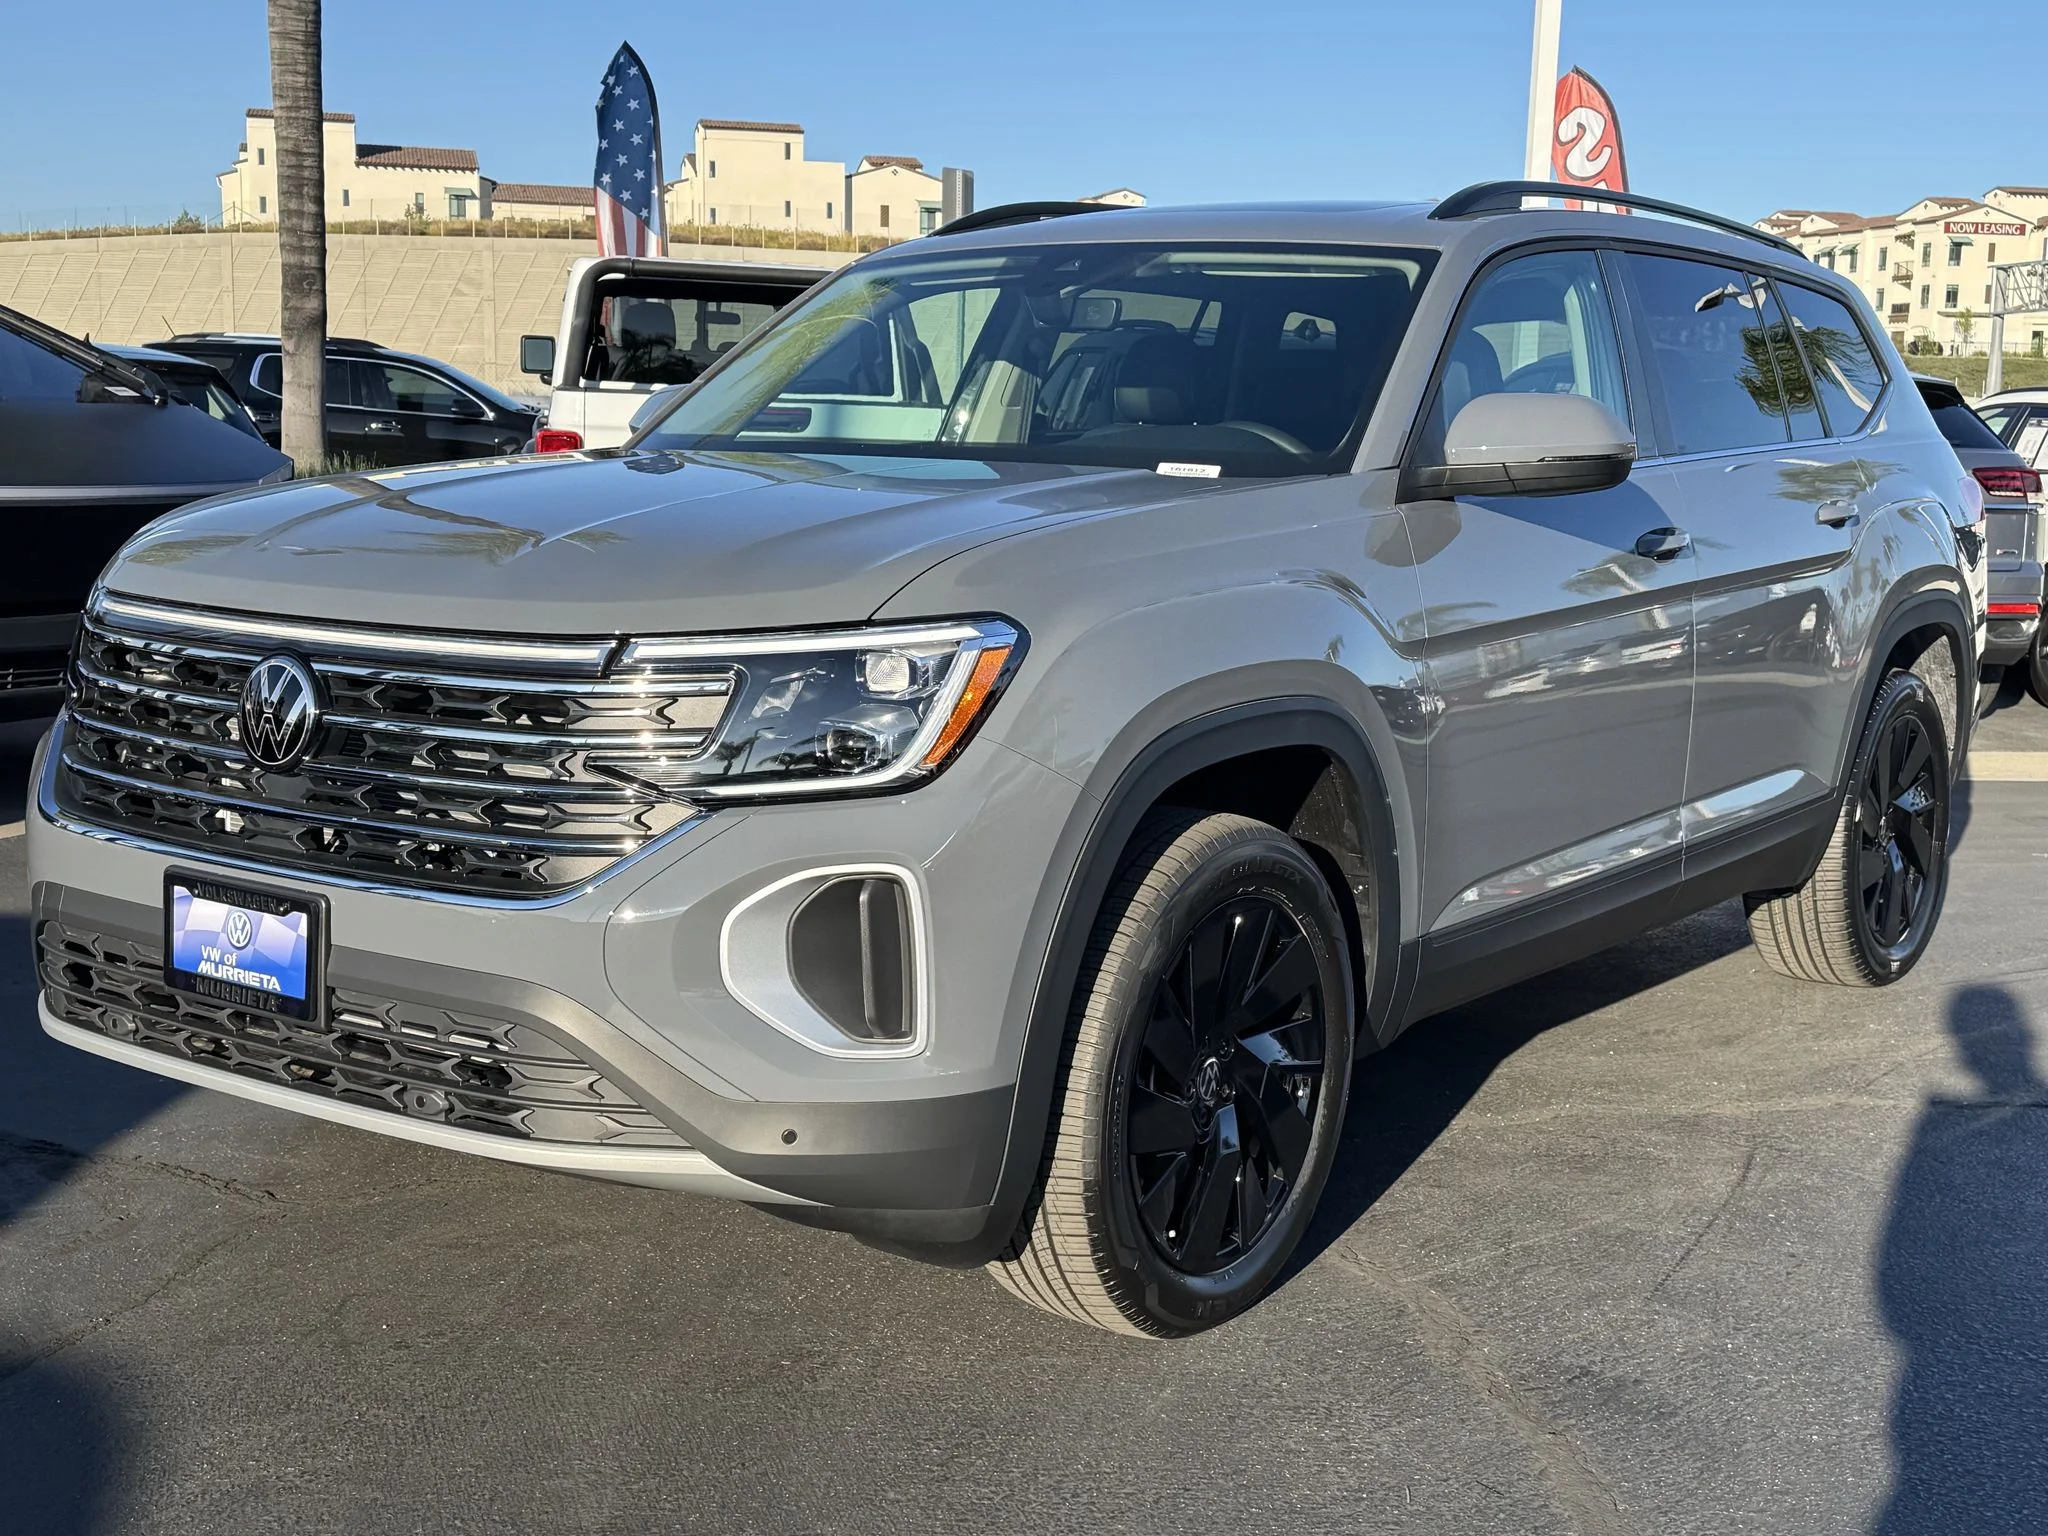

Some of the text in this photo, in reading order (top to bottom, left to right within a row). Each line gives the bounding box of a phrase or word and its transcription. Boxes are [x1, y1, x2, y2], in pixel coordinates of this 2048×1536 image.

[1949, 222, 2021, 235] NOW LEASING
[243, 660, 312, 766] VW
[196, 882, 277, 913] VOLKSWAGEN
[228, 910, 251, 949] VW
[201, 944, 238, 967] VW of
[197, 960, 281, 992] MURRIETA
[195, 976, 278, 1012] MURRIETA
